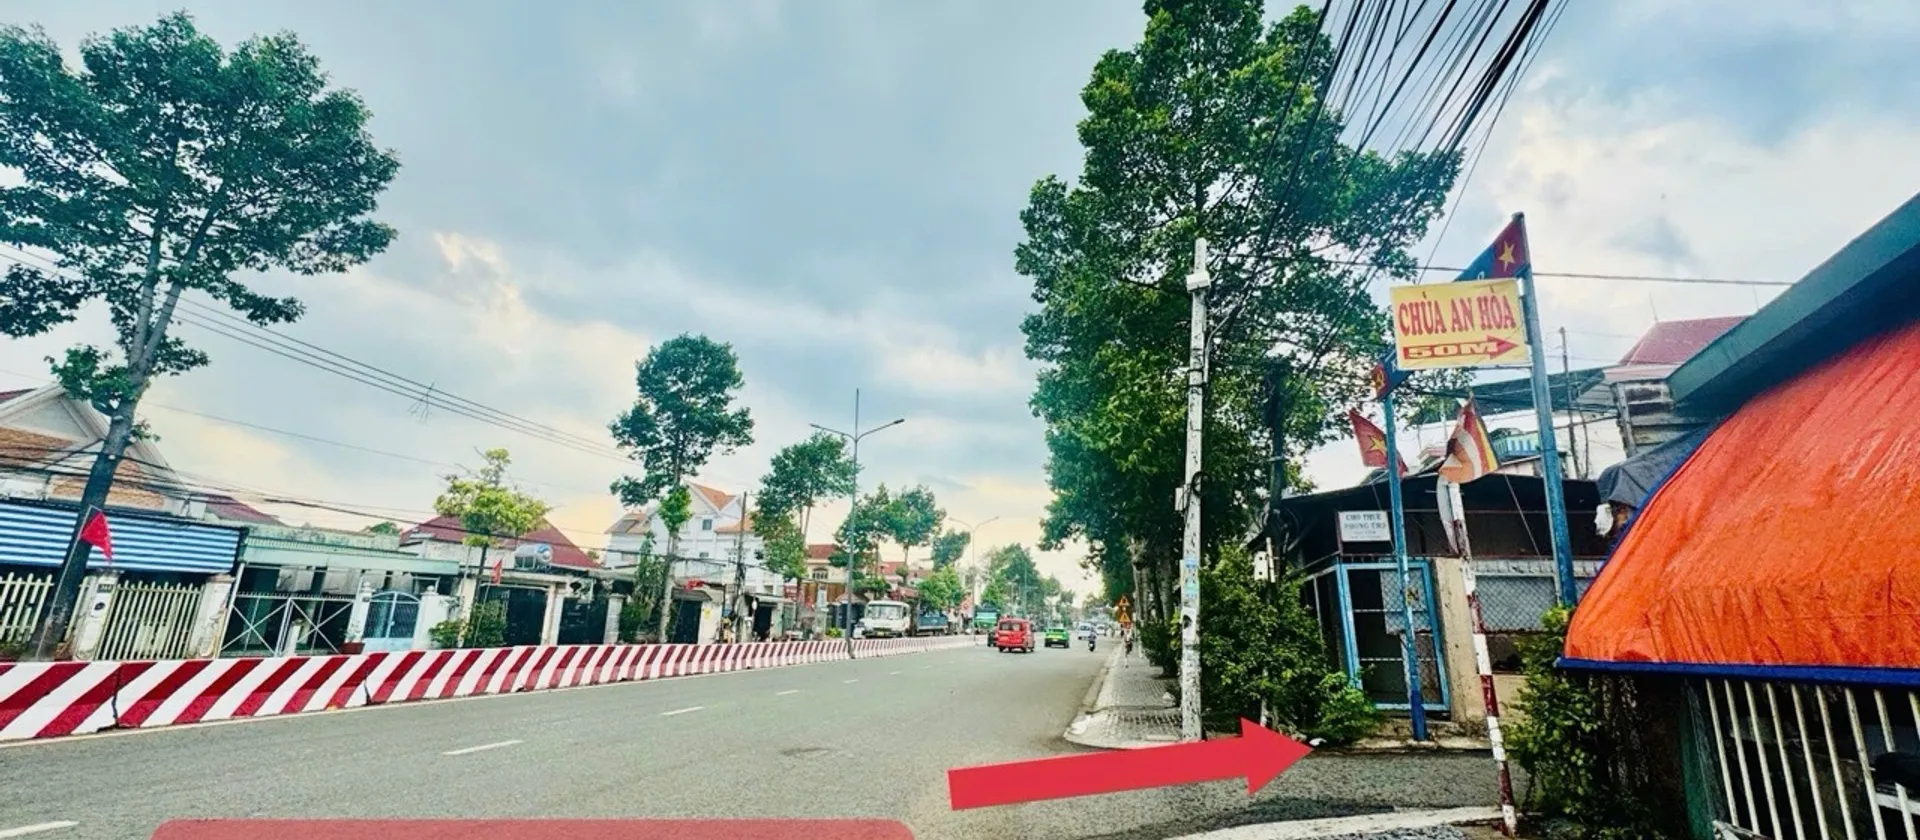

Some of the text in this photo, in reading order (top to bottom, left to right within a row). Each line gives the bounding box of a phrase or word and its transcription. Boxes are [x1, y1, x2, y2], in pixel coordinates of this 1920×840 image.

[1398, 285, 1516, 336] CHÙA AN HÒA
[1408, 342, 1497, 358] 50M
